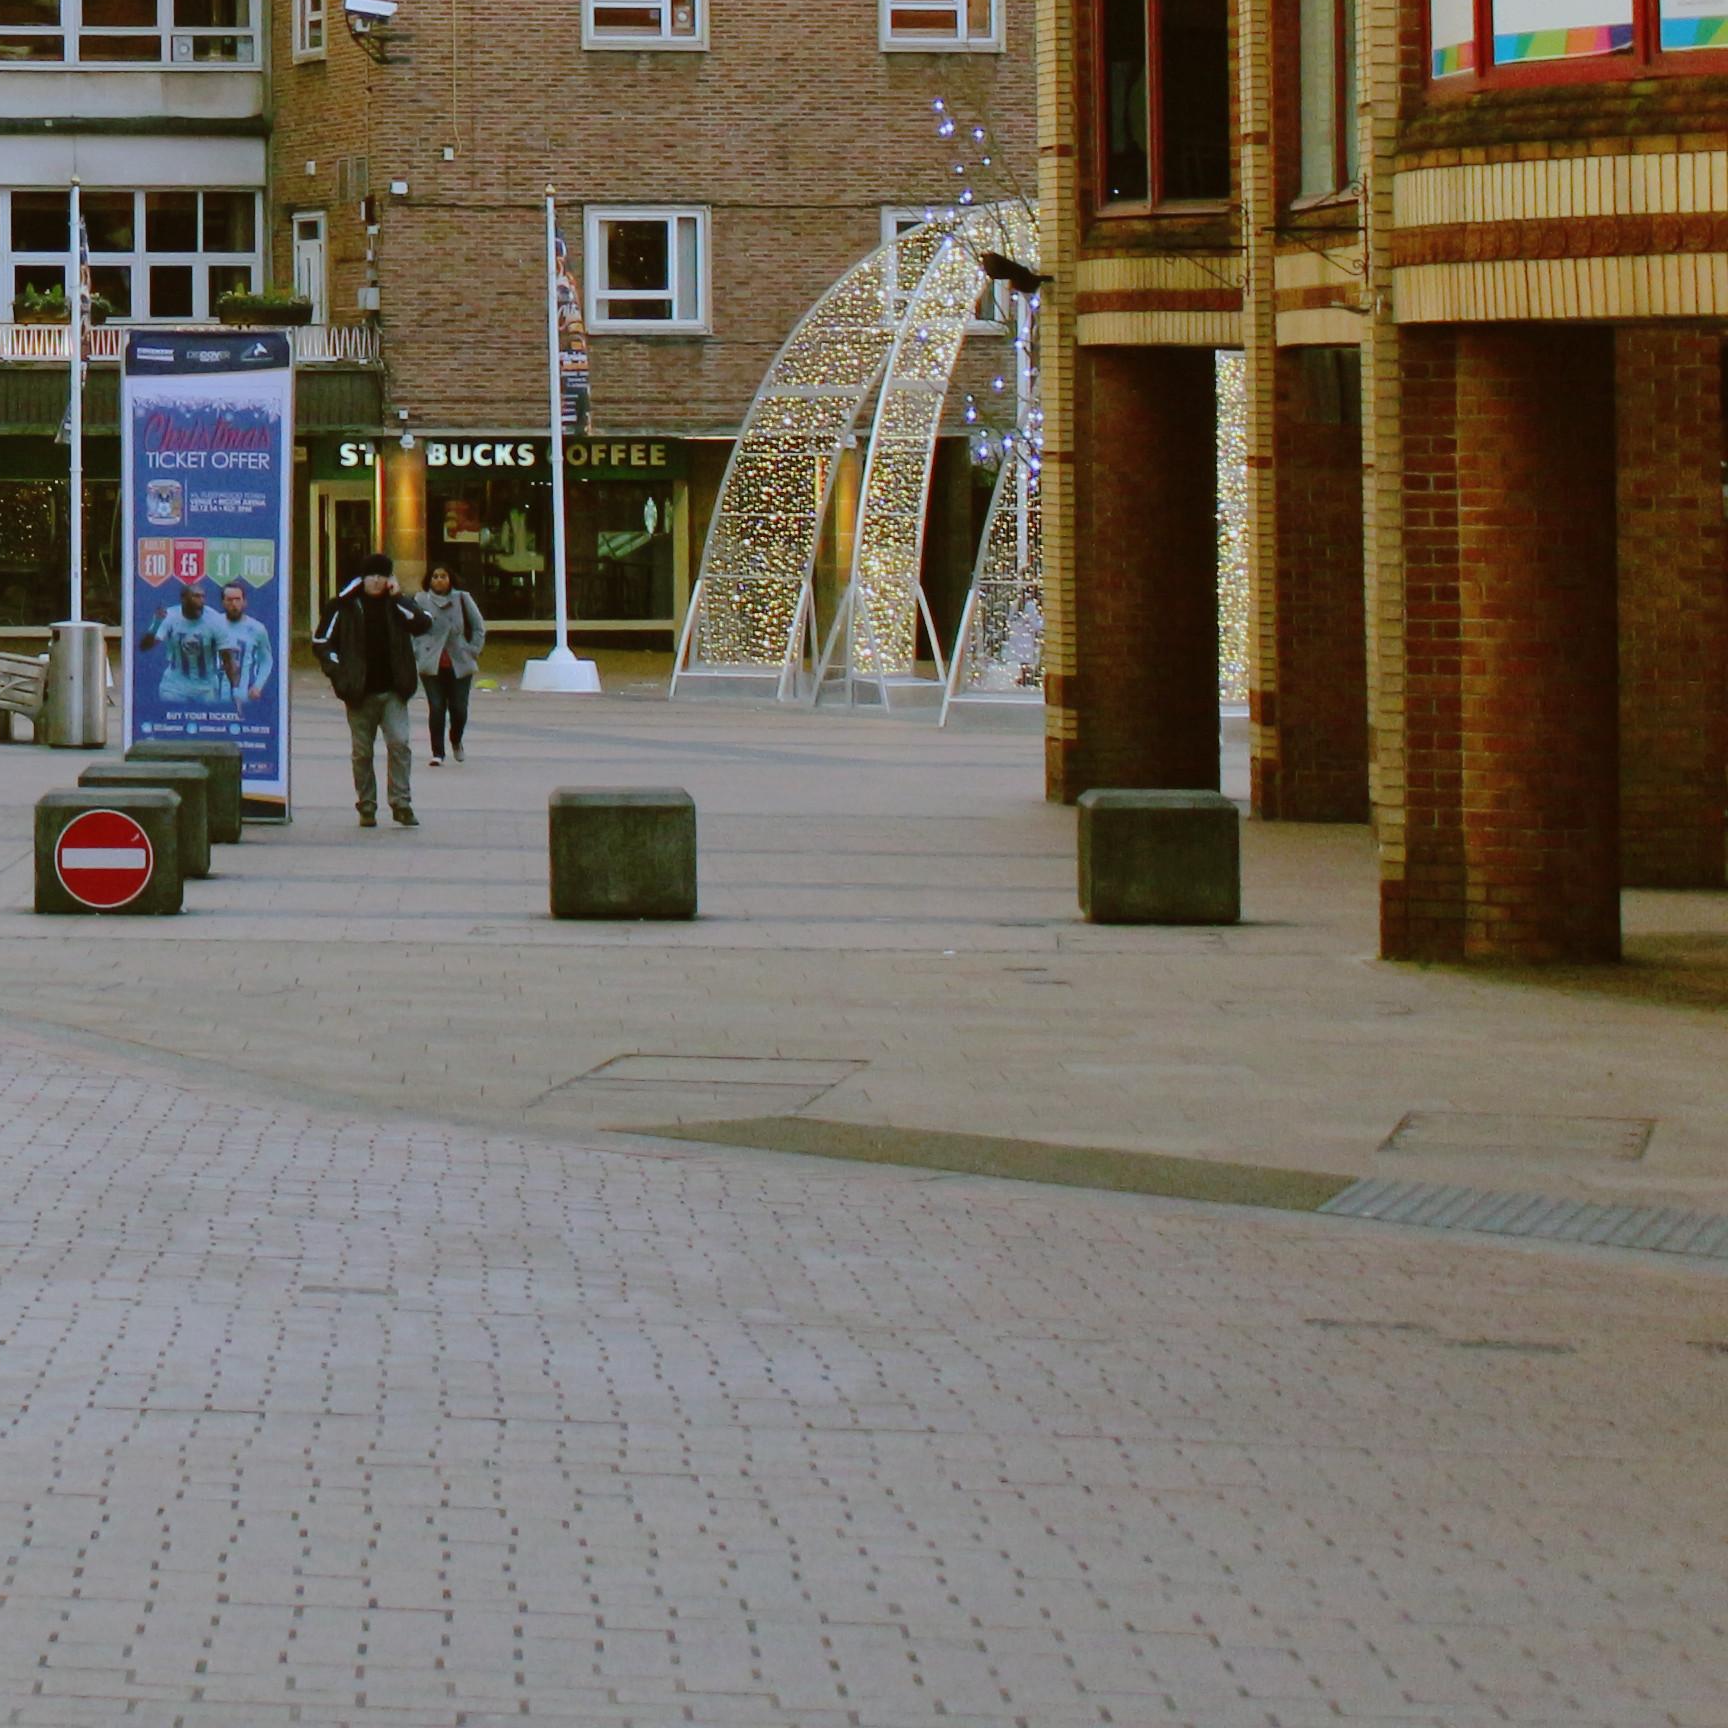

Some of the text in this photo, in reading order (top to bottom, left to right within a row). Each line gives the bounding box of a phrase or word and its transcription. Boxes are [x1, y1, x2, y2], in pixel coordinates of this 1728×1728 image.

[144, 410, 271, 453] Christmas
[146, 451, 271, 470] TICKET OFFER
[144, 553, 167, 577] £10
[180, 552, 199, 577] £5
